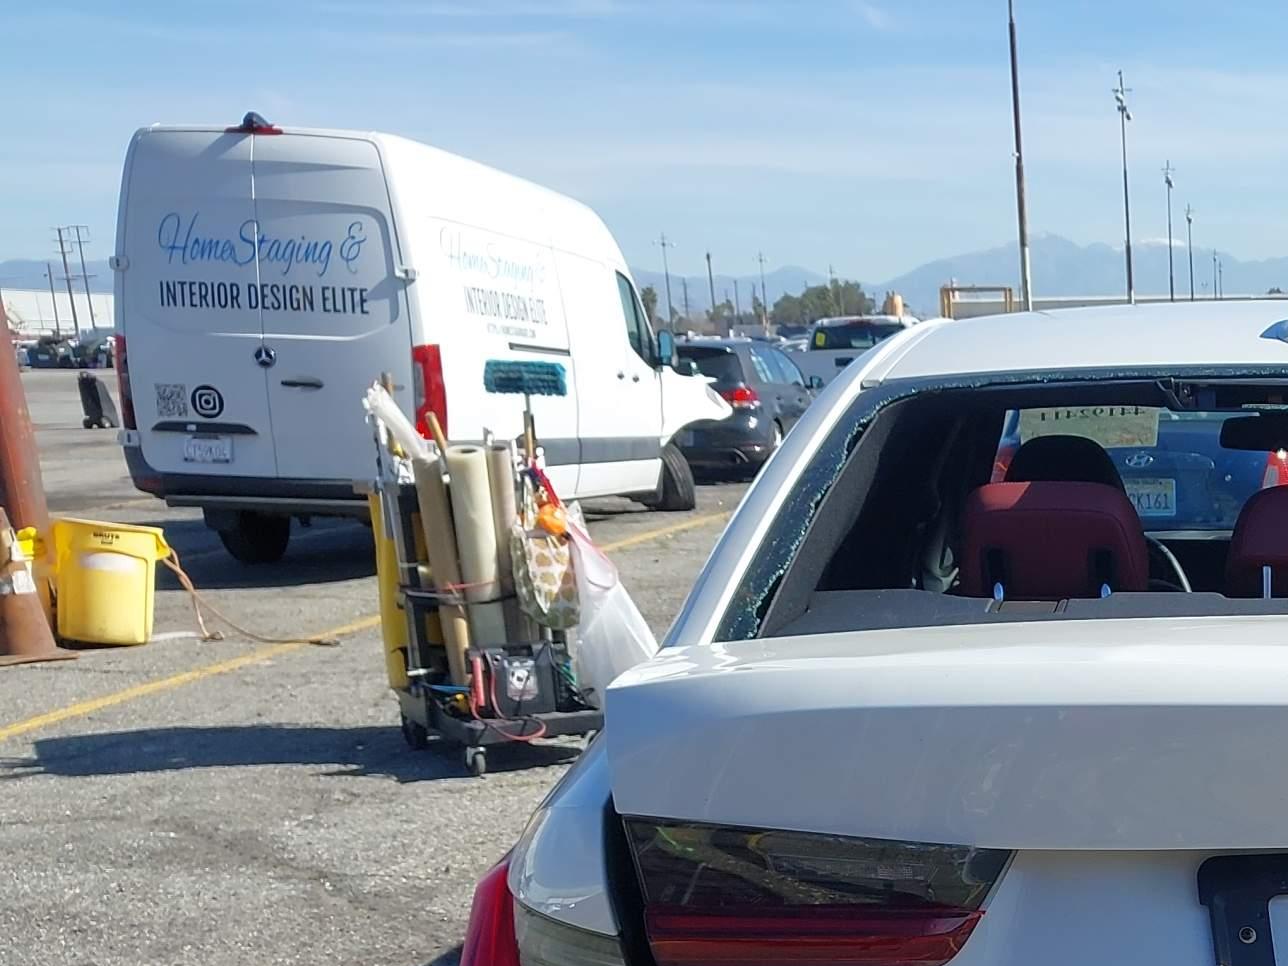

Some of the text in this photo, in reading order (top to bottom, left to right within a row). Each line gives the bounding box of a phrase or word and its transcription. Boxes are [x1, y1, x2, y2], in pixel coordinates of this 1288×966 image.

[340, 221, 367, 275] &
[159, 280, 369, 315] INTERIOR DESIGN ELITE
